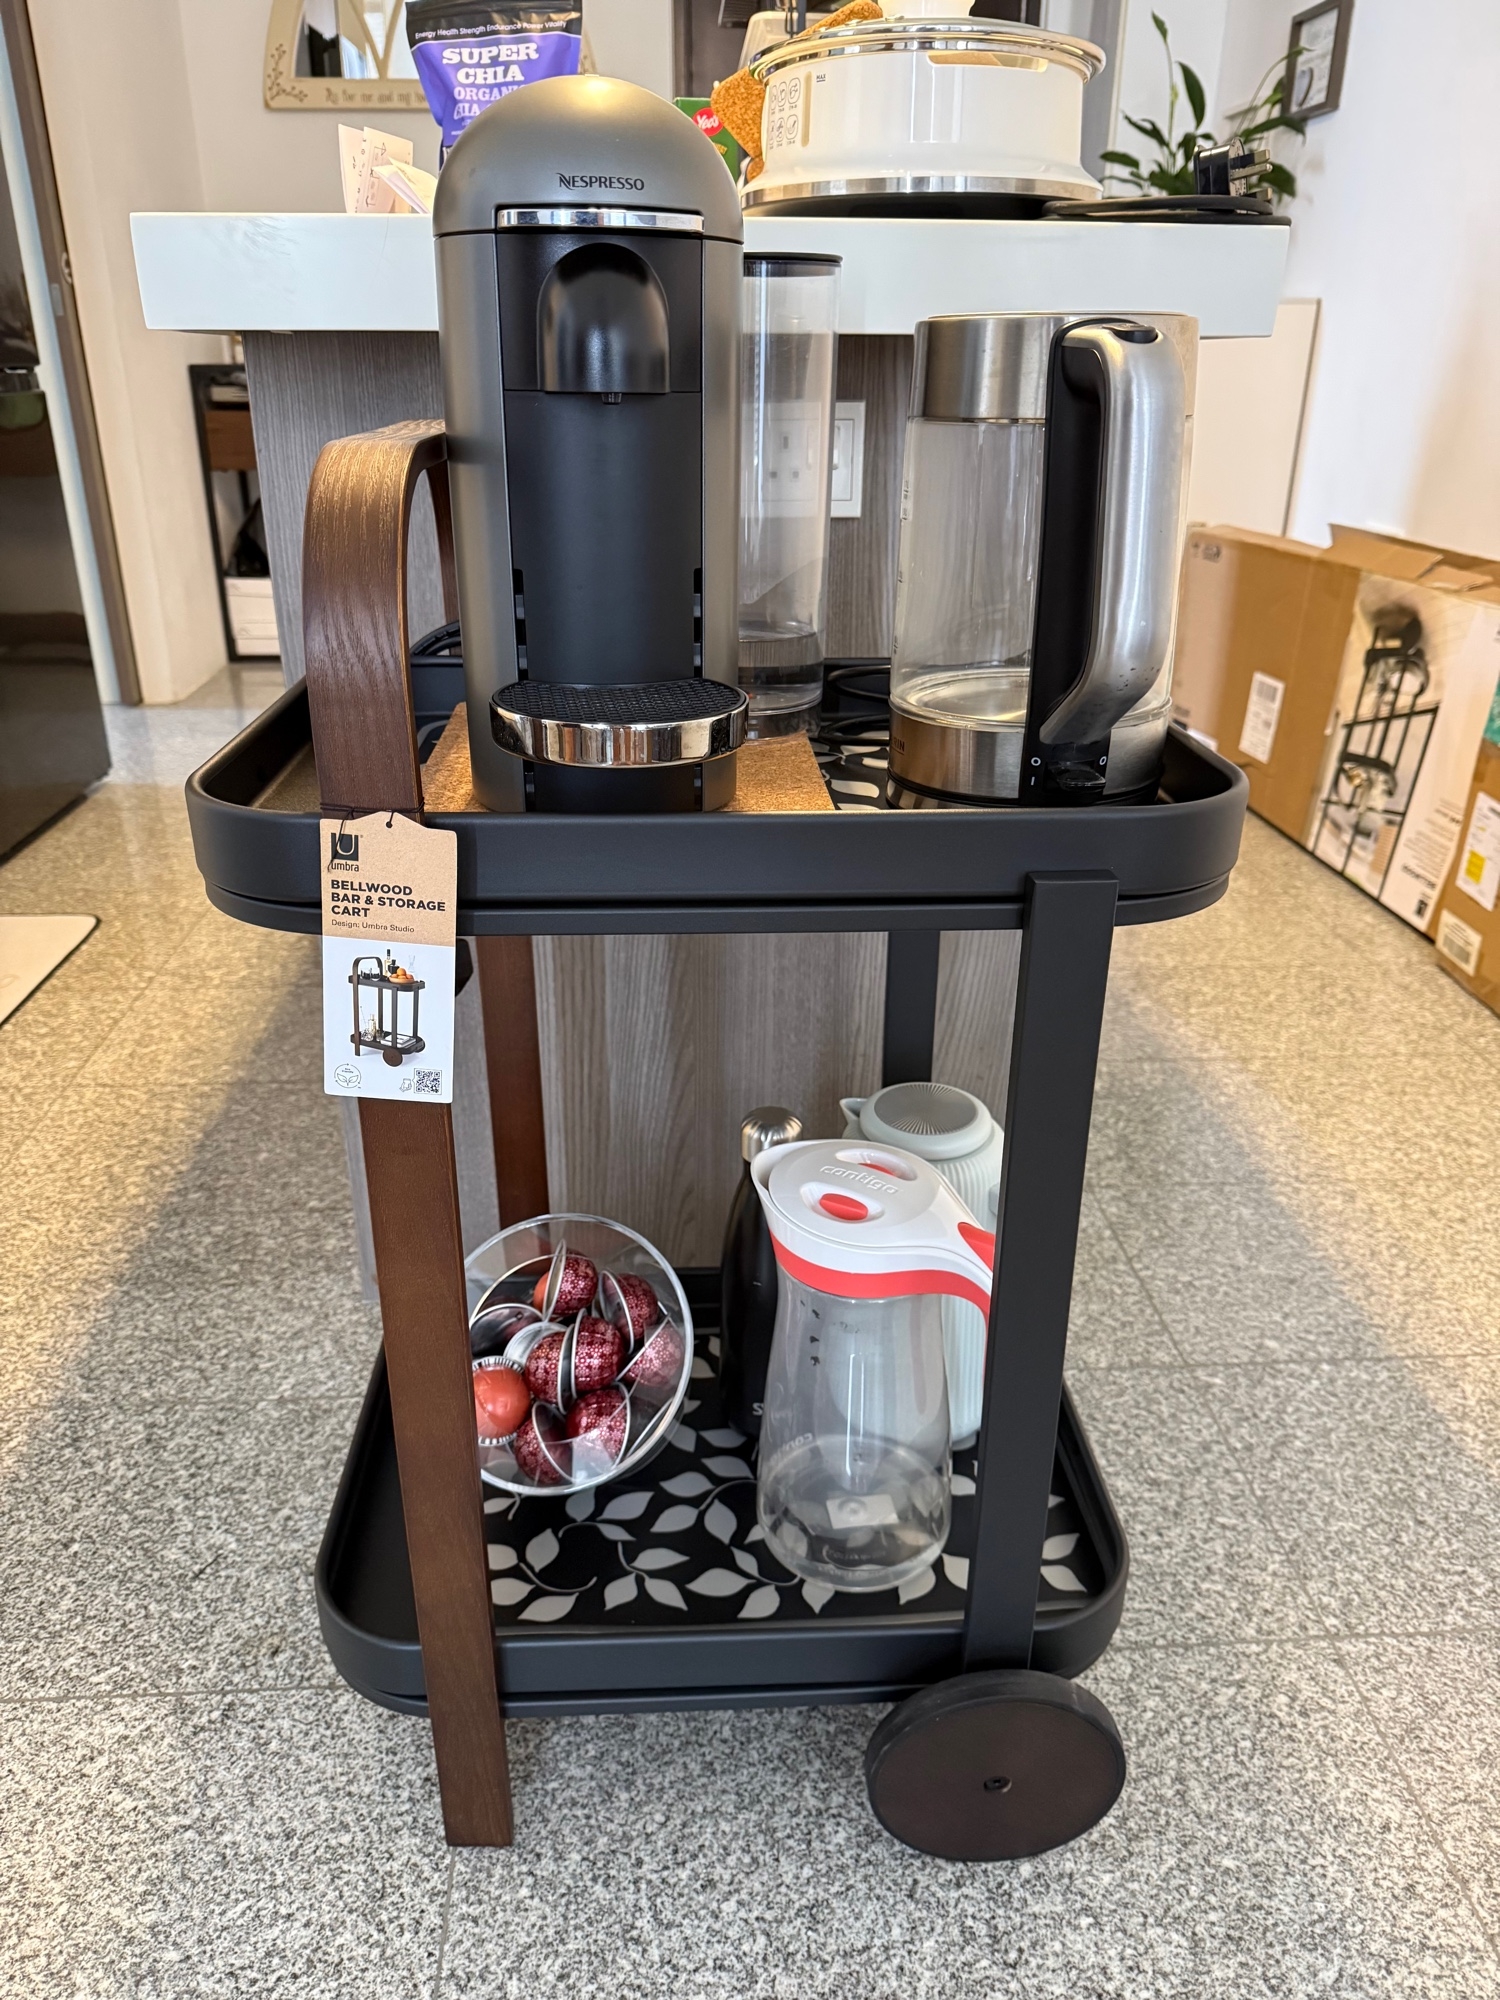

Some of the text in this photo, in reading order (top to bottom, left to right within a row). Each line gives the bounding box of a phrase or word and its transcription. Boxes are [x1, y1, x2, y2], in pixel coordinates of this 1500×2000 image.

[415, 20, 567, 39] Energy Health Strength Endurance Power Vitality
[442, 42, 539, 65] SUPER
[457, 65, 525, 84] CHIA
[556, 172, 645, 191] NESPRESSO
[331, 862, 360, 872] umbra
[331, 879, 413, 896] BELLWOOD
[331, 892, 446, 912] BAR & STORAGE
[331, 905, 370, 918] CART
[331, 919, 415, 933] Design: Umbra Studio
[820, 1165, 899, 1194] contigo
